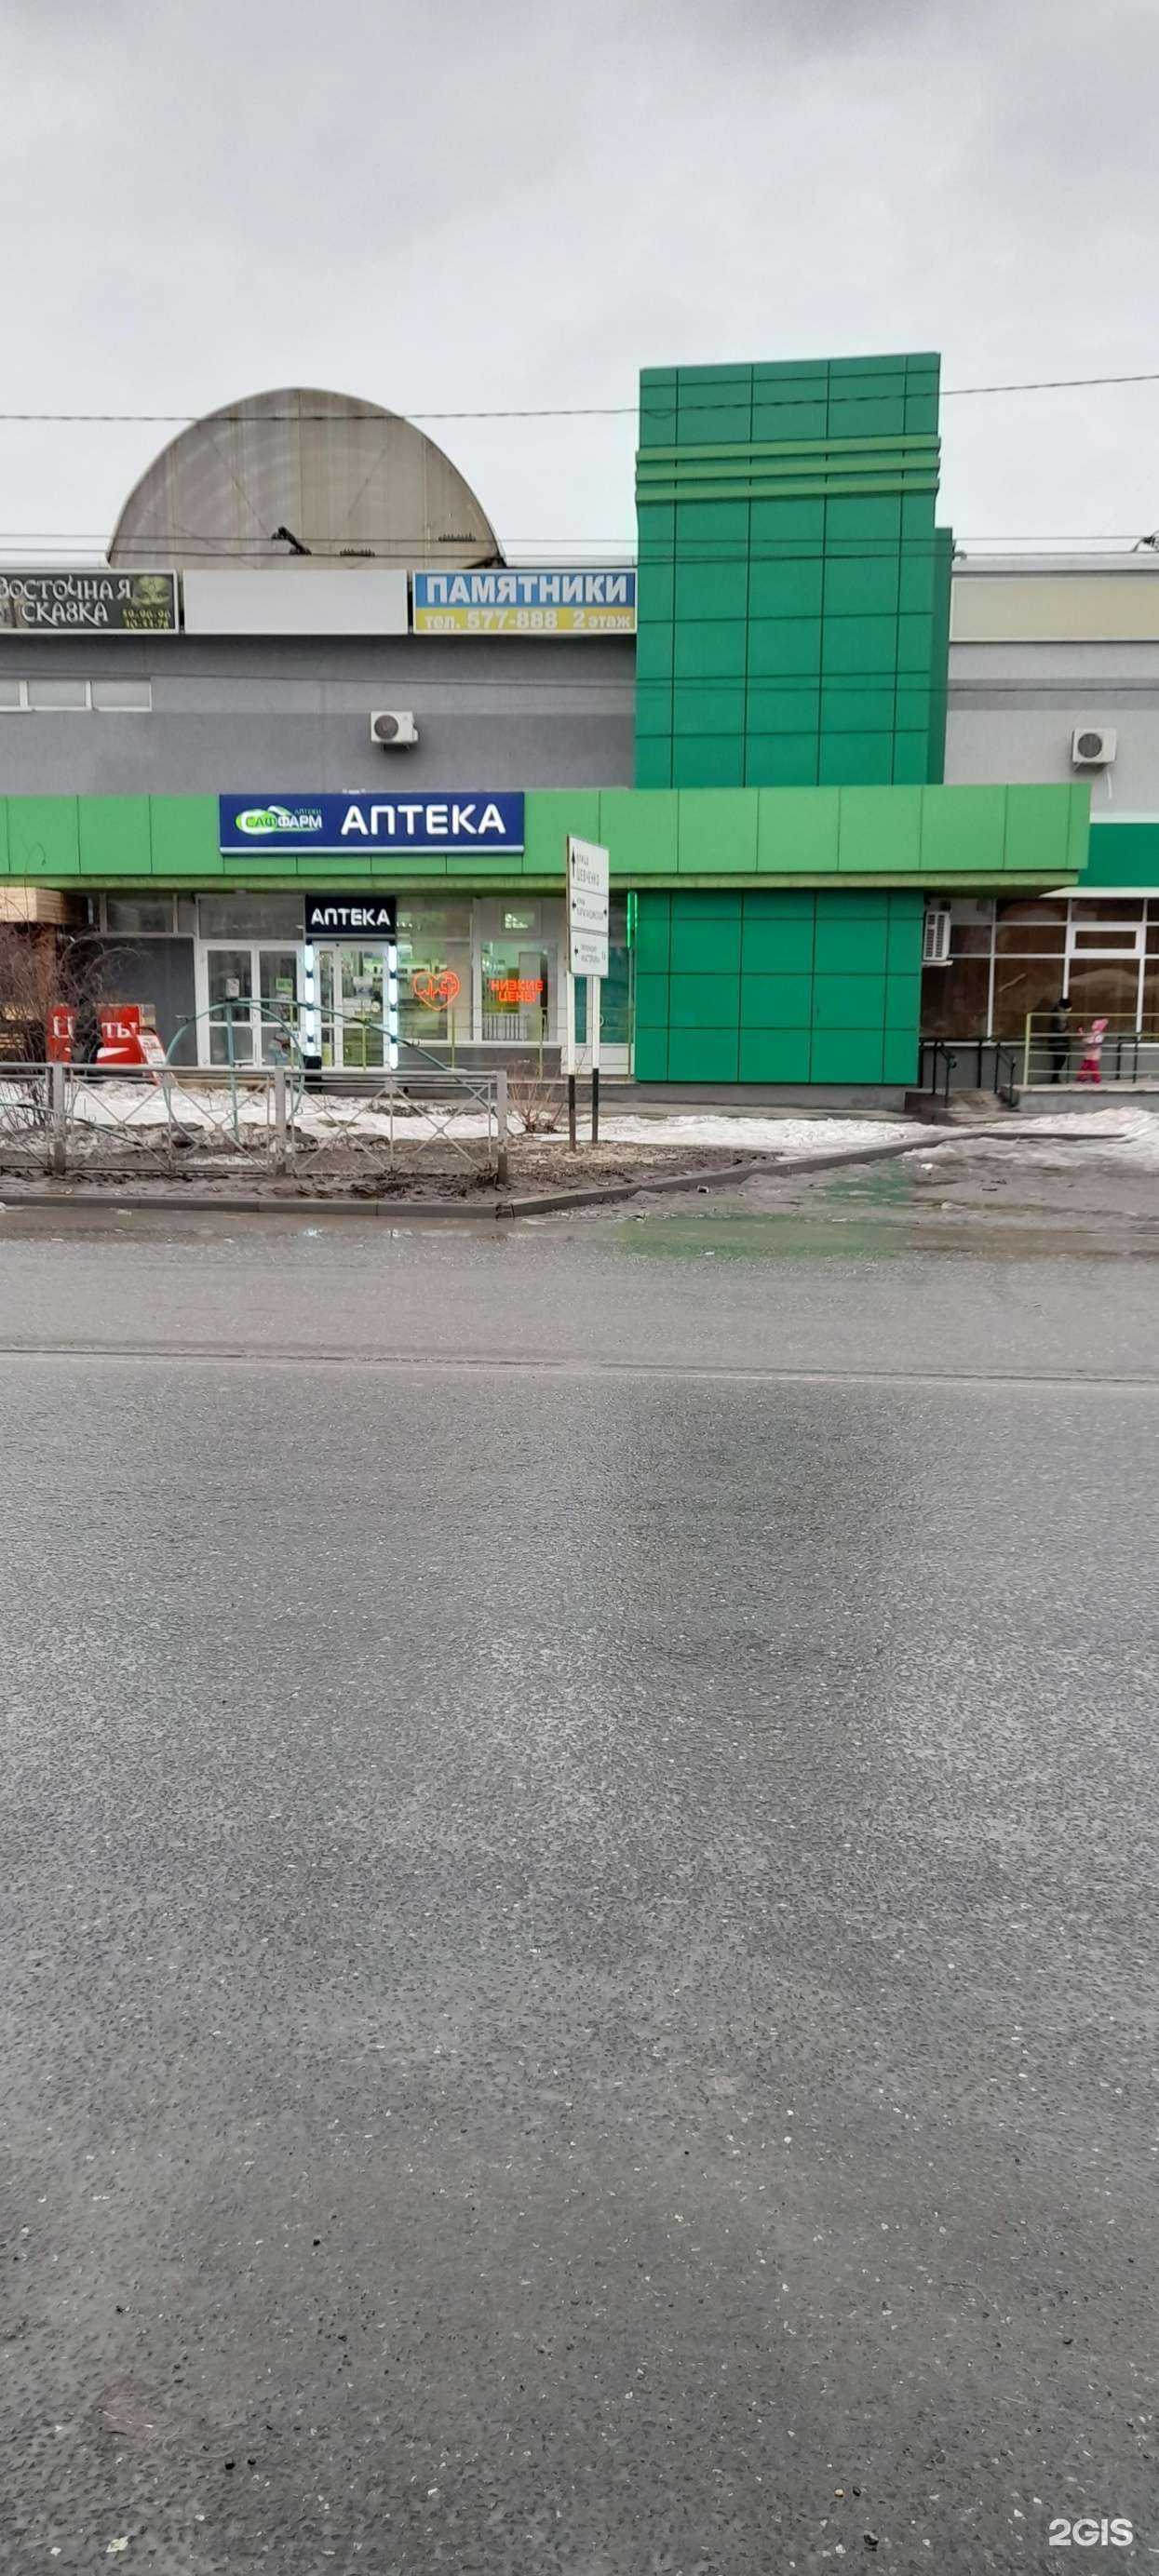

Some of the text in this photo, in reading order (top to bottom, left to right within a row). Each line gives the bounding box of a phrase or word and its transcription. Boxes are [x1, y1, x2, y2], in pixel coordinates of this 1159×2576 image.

[0, 575, 131, 601] ВОСТОЧНАЯ
[426, 575, 627, 604] ПАМЯТНИКИ
[21, 601, 109, 626] СКАЗКА
[425, 610, 631, 629] тел. 577-888 2 этаж
[341, 803, 506, 836] АПТЕКА
[311, 907, 391, 927] АПТЕКА
[491, 979, 544, 991] НИЗКИЕ
[498, 991, 536, 1003] ЦЕНЫ
